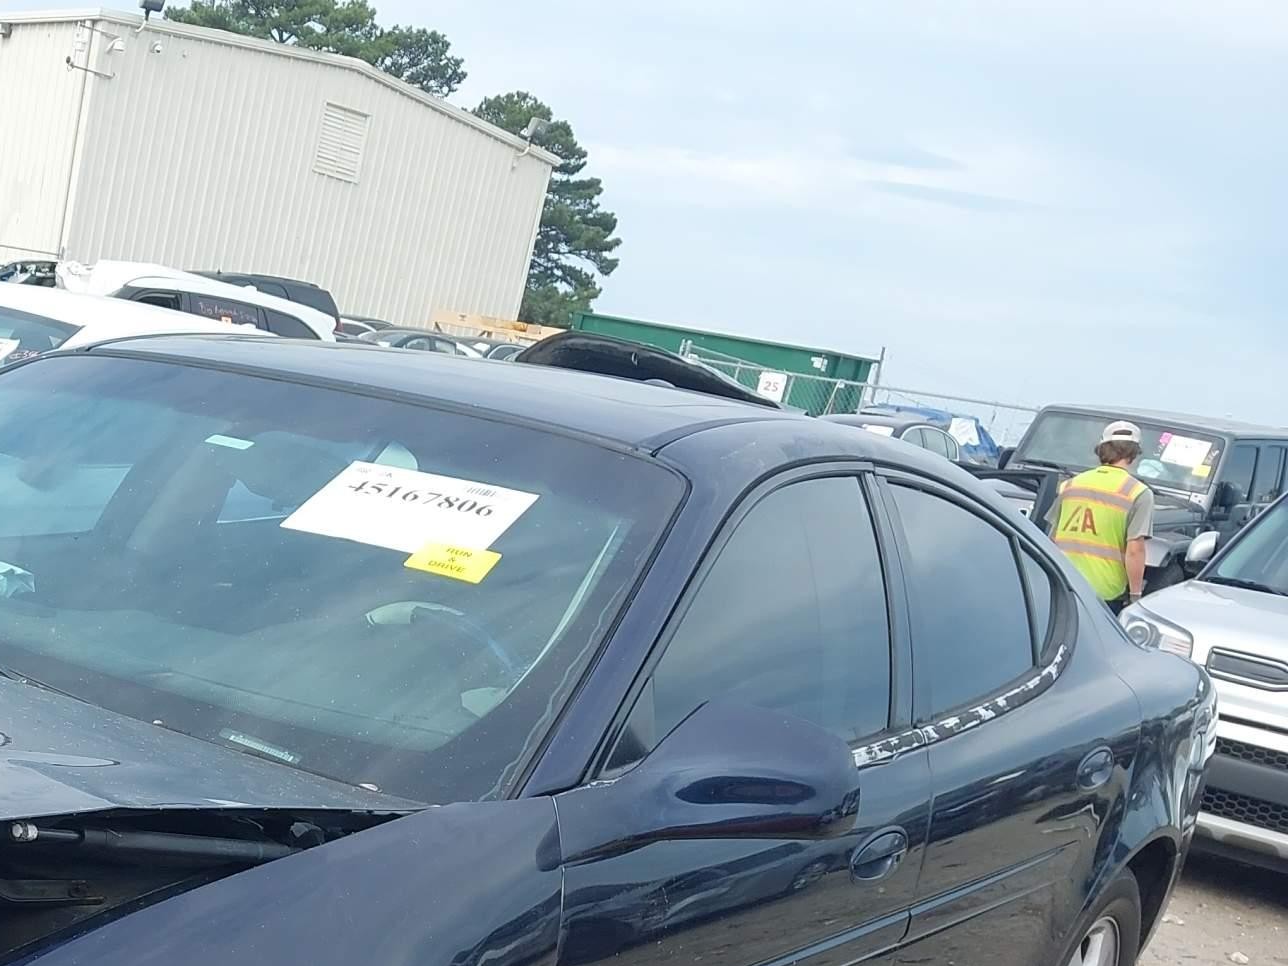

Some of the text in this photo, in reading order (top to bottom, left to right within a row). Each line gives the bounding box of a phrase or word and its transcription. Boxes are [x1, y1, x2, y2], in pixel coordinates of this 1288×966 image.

[763, 381, 779, 392] 25
[348, 480, 494, 518] 45167806
[446, 547, 473, 557] RUN
[428, 559, 466, 573] DRIVE
